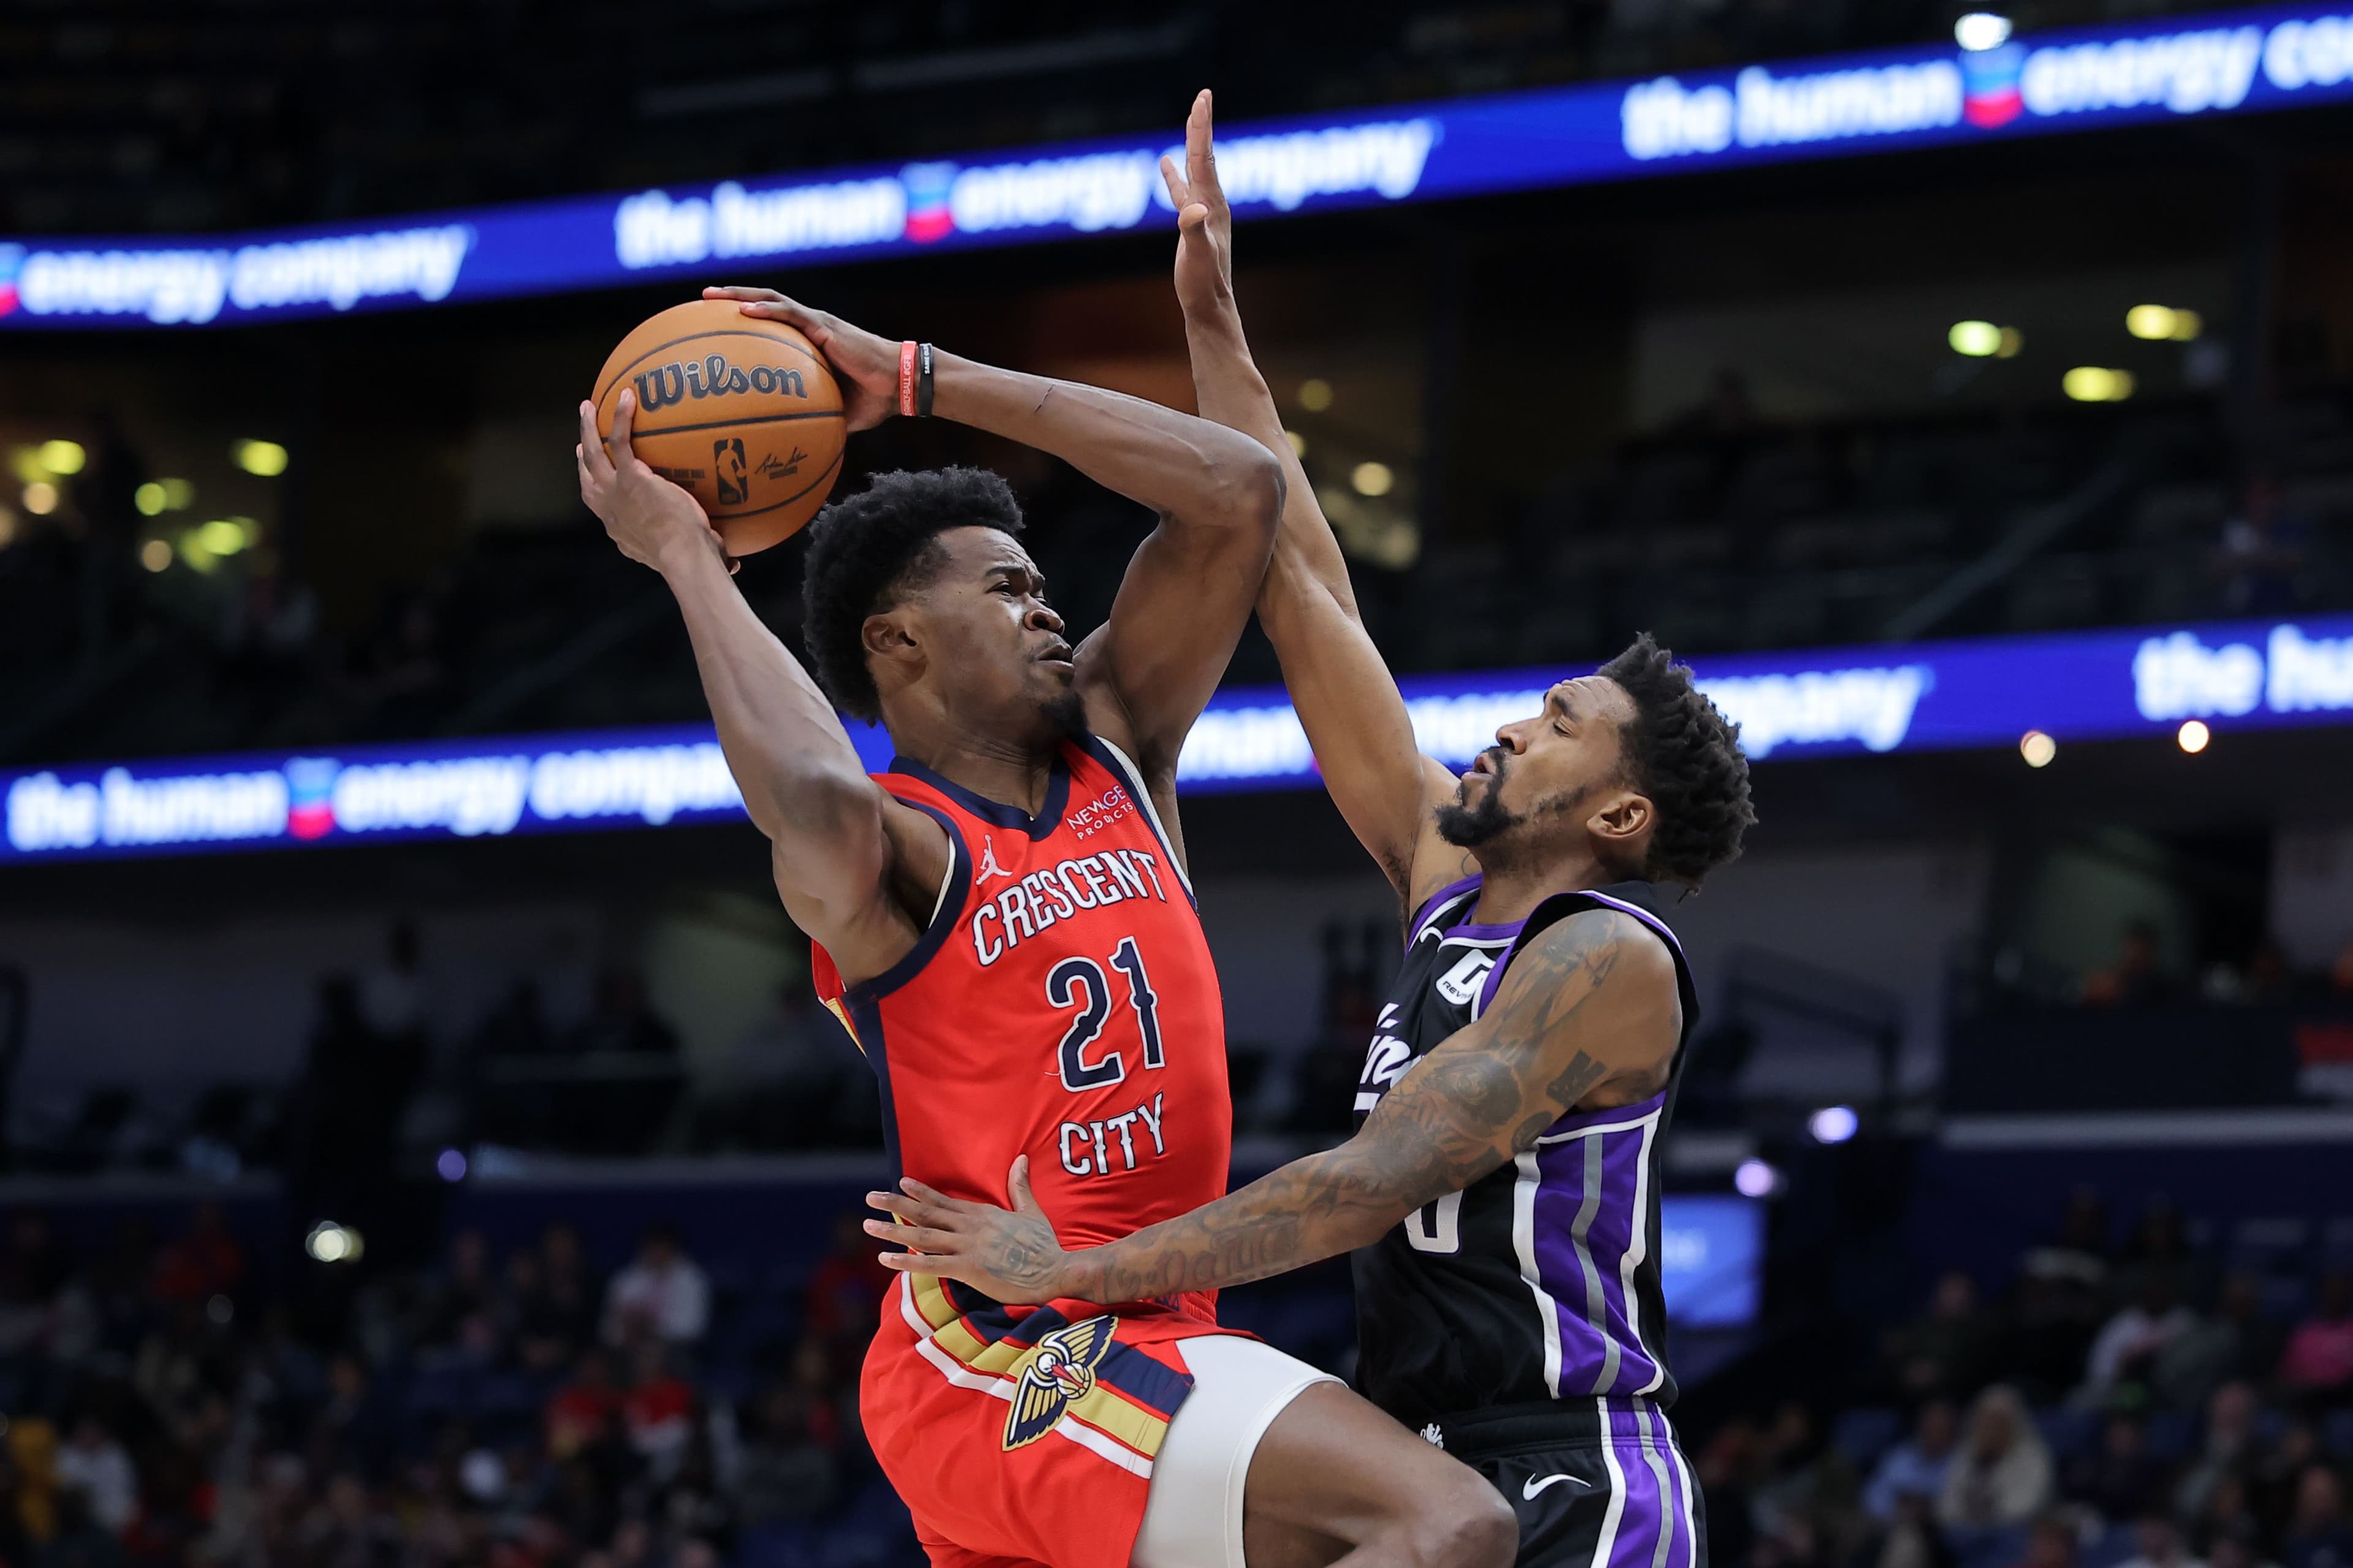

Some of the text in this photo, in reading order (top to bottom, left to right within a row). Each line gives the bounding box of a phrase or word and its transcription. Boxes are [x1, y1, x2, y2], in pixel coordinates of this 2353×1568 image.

[1623, 16, 2353, 161] the human energy co
[615, 190, 711, 270] the
[711, 181, 906, 259] human
[950, 149, 1154, 232] energy
[20, 225, 471, 324] energy company
[633, 354, 808, 412] Wilson
[2132, 631, 2266, 722] the
[7, 771, 100, 851] the
[100, 767, 289, 847] human
[333, 754, 531, 836] energy
[972, 849, 1167, 967] CRESCENT
[1045, 936, 1165, 1092] 21
[1059, 1089, 1164, 1175] CITY
